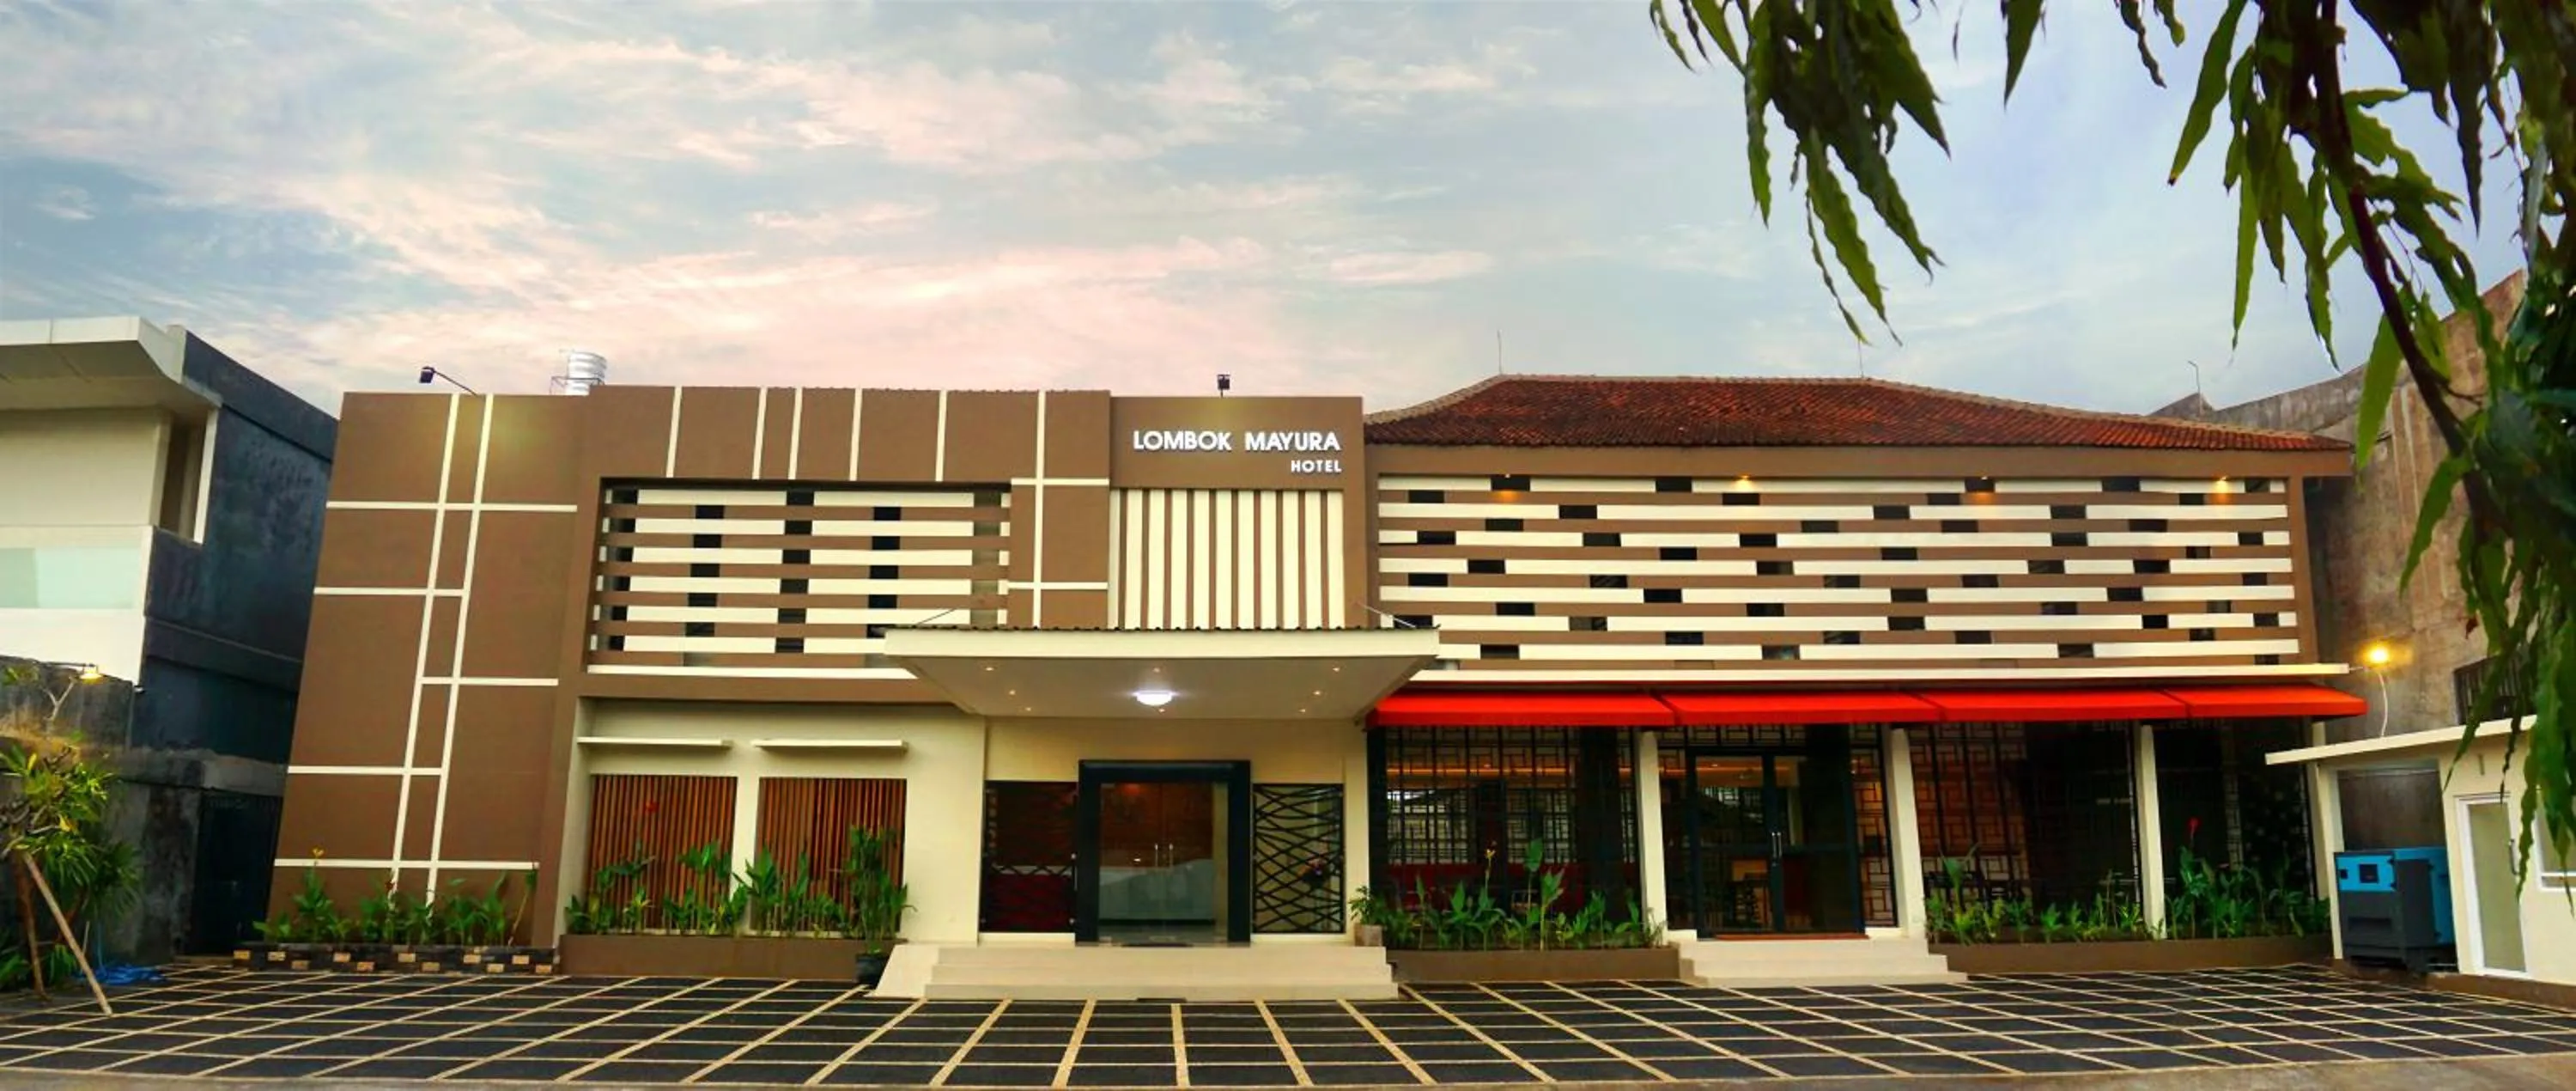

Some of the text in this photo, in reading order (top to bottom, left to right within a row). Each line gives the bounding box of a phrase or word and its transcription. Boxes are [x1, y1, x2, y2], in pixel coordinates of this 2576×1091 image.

[1133, 430, 1341, 451] LOMBOK MAYURA
[1291, 460, 1342, 472] HOTEL
